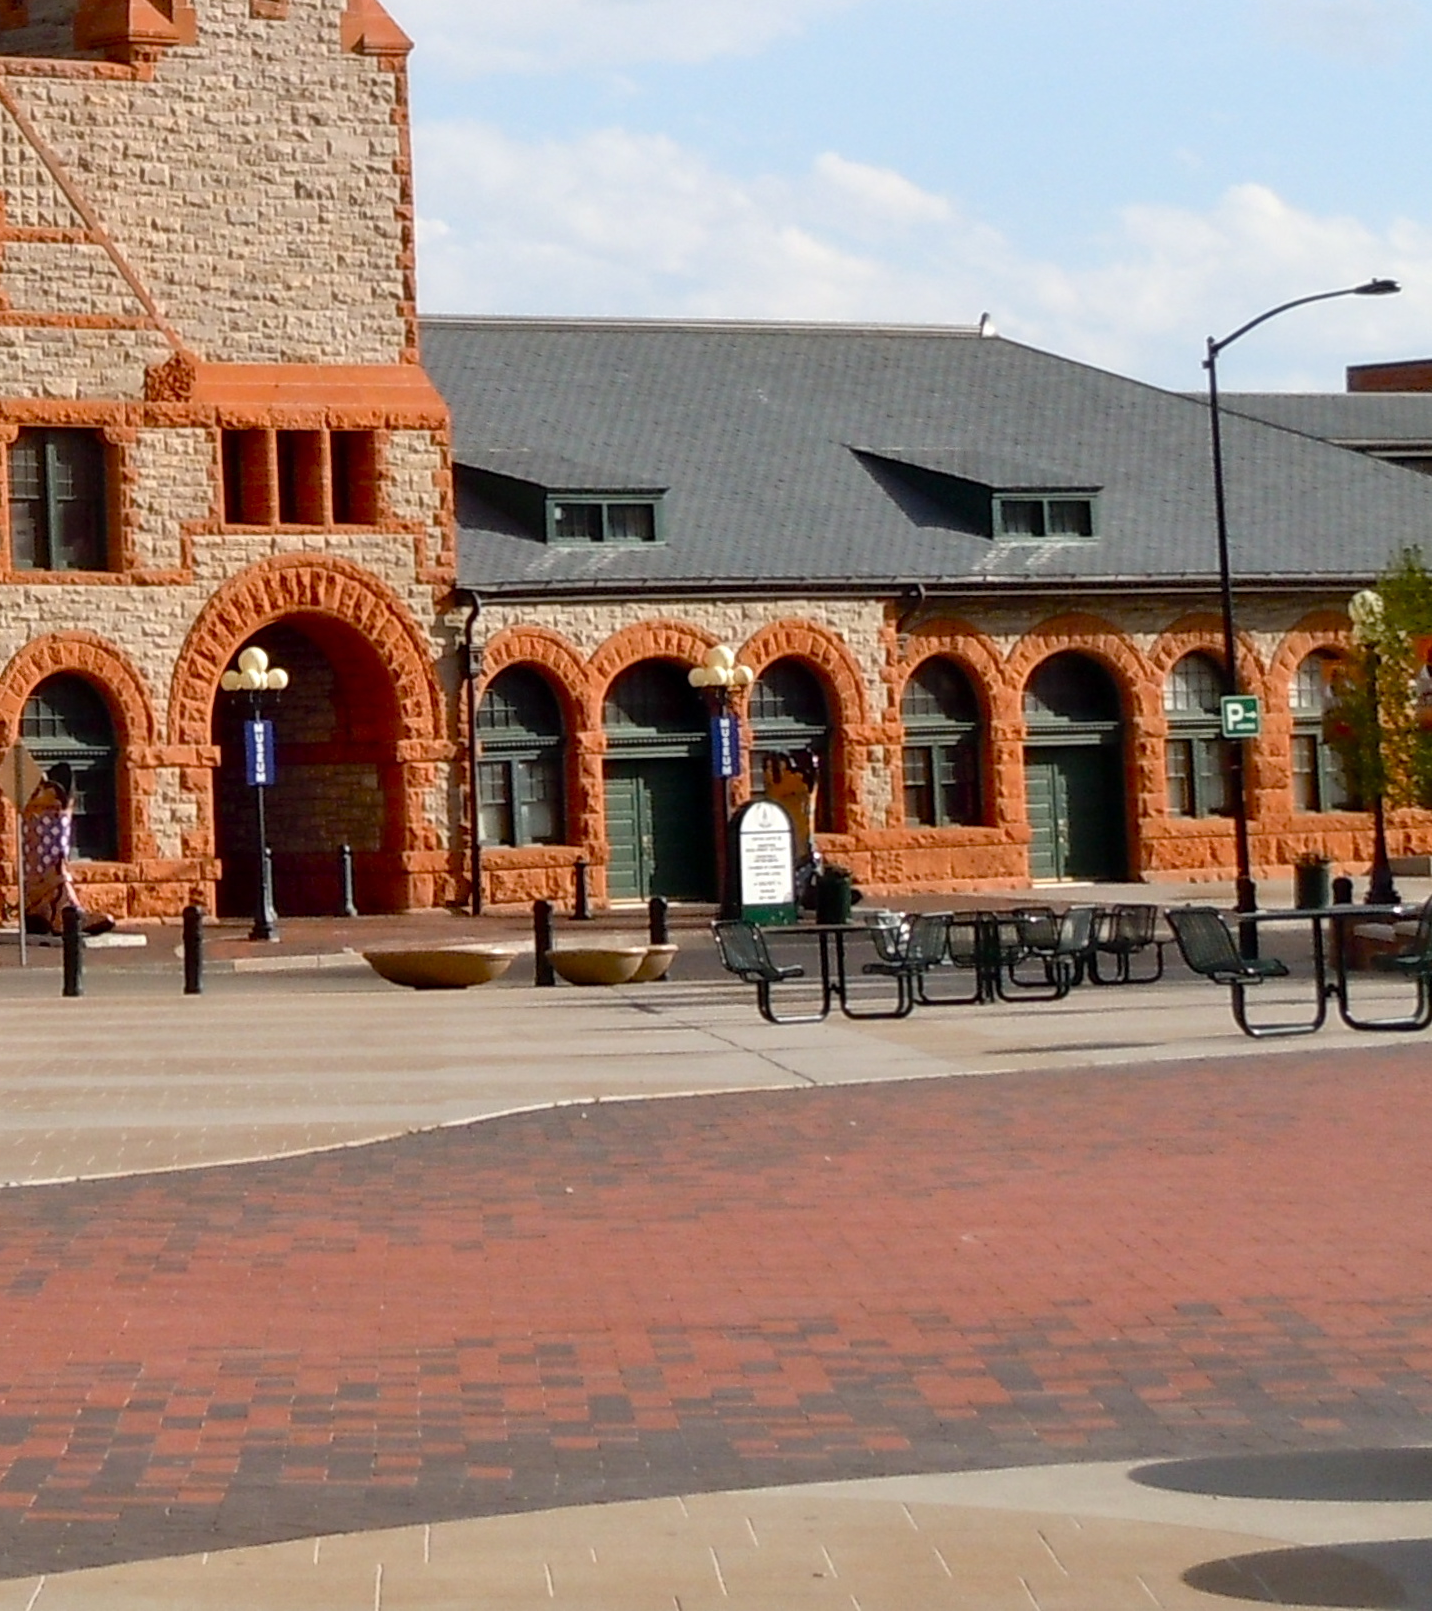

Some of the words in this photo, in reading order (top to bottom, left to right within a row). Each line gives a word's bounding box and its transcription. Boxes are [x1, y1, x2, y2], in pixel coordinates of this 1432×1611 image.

[1226, 703, 1244, 730] P
[253, 723, 265, 782] MUSEUM
[719, 718, 732, 775] MUSEUM
